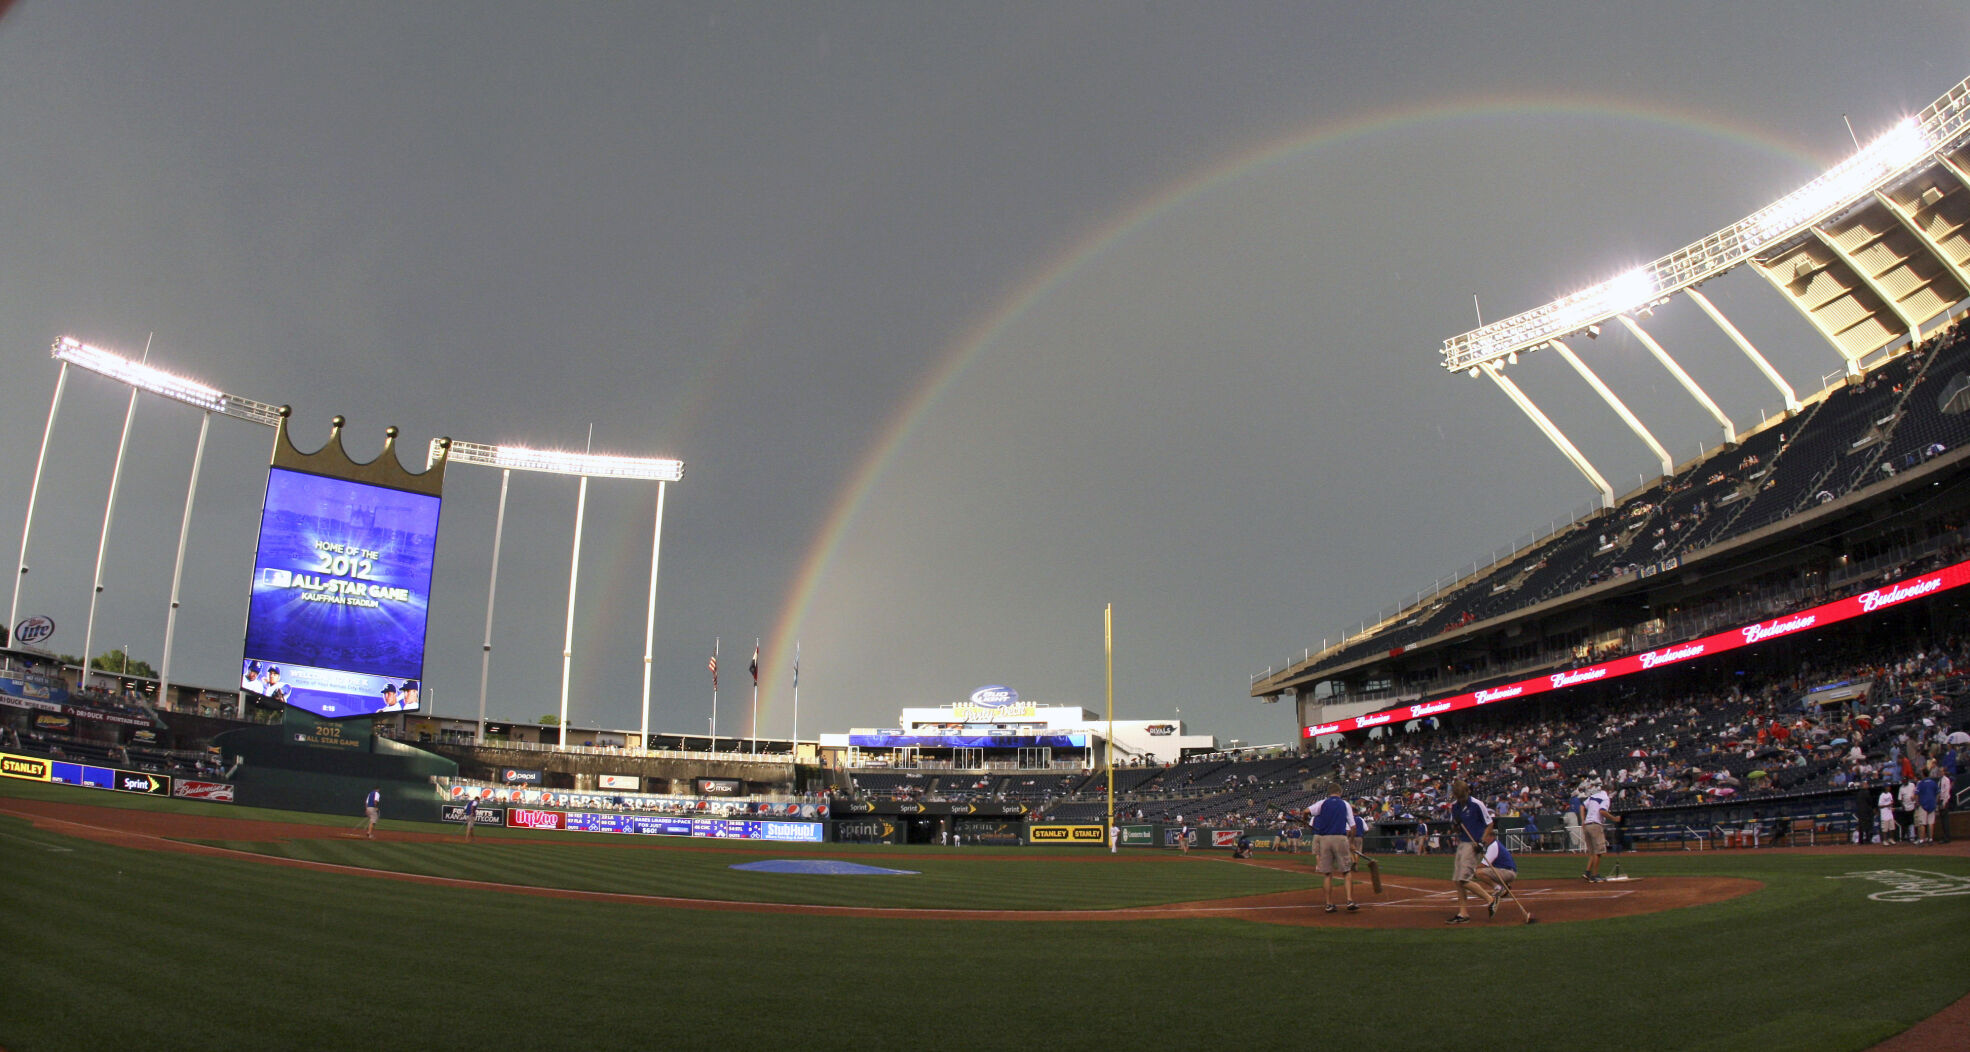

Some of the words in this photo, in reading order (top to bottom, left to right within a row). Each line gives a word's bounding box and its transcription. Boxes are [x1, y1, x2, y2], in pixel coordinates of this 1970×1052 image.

[315, 541, 344, 553] HOME
[346, 545, 359, 555] OF
[362, 550, 379, 560] THE
[317, 552, 372, 580] 2012
[291, 574, 367, 597] ALL-STAR
[369, 585, 409, 601] GAME
[301, 592, 346, 604] KAUFFMAN
[346, 598, 379, 608] STADIUM
[1859, 579, 1940, 612] Budweiser
[22, 625, 49, 641] Lite
[1742, 616, 1815, 643] Budweiser
[1640, 645, 1704, 668] Budweiser
[1551, 669, 1605, 688] Budweiser
[1475, 687, 1522, 704] Budweiser
[1411, 702, 1450, 717] Budweiser
[1356, 714, 1390, 728] Budweiser
[316, 726, 341, 737] 2012
[3, 760, 44, 775] STANLEY
[124, 777, 149, 790] Sprint
[180, 783, 225, 796] Budweiser
[715, 784, 732, 792] max
[850, 803, 867, 812] Sprint
[900, 804, 918, 814] Sprint
[951, 805, 968, 814] Sprint
[1002, 806, 1020, 815] Sprint
[768, 823, 815, 837] StubHub!
[838, 822, 878, 837] Sprint
[1035, 830, 1067, 838] STANLEY
[1074, 830, 1100, 838] STANLEY
